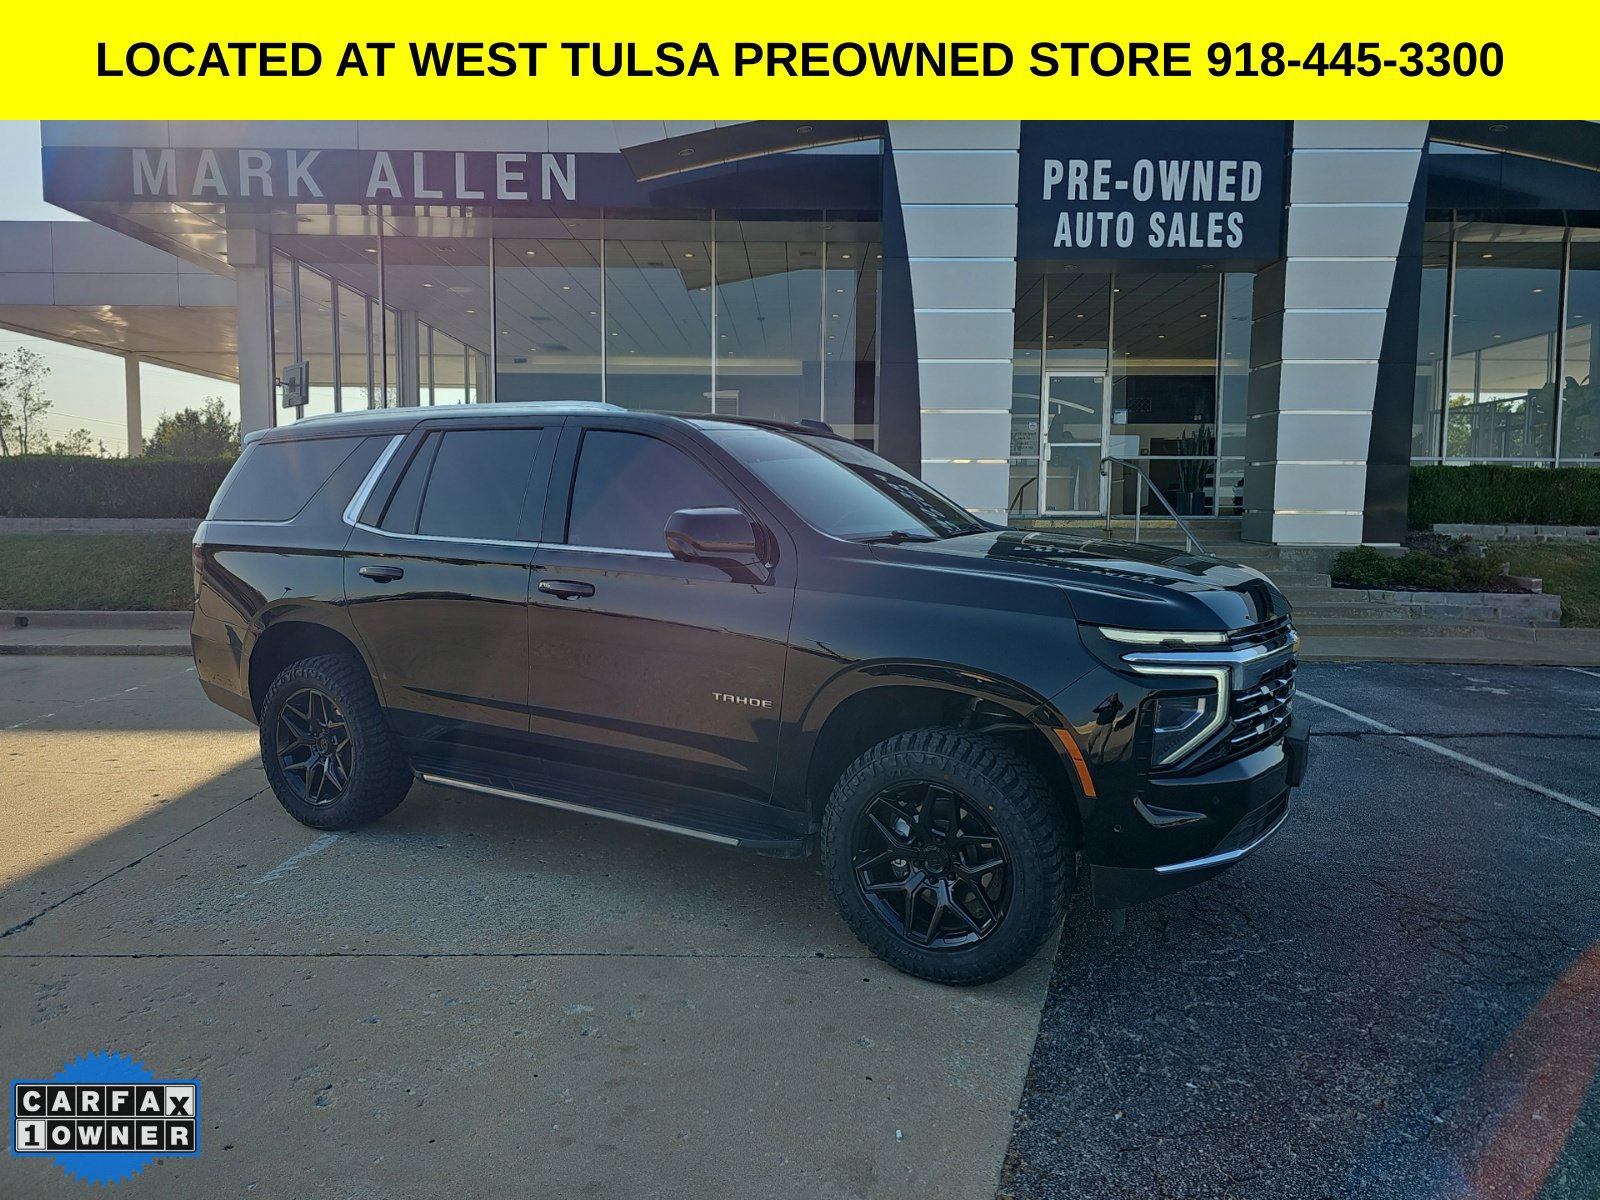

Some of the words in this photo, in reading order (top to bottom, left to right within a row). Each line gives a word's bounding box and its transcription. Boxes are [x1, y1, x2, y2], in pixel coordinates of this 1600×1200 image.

[132, 147, 325, 198] MARK
[365, 150, 578, 202] ALLEN
[1042, 158, 1264, 203] PRE-OWNED
[1053, 210, 1133, 249] AUTO
[1148, 210, 1245, 249] SALES
[712, 691, 773, 709] TAHOE
